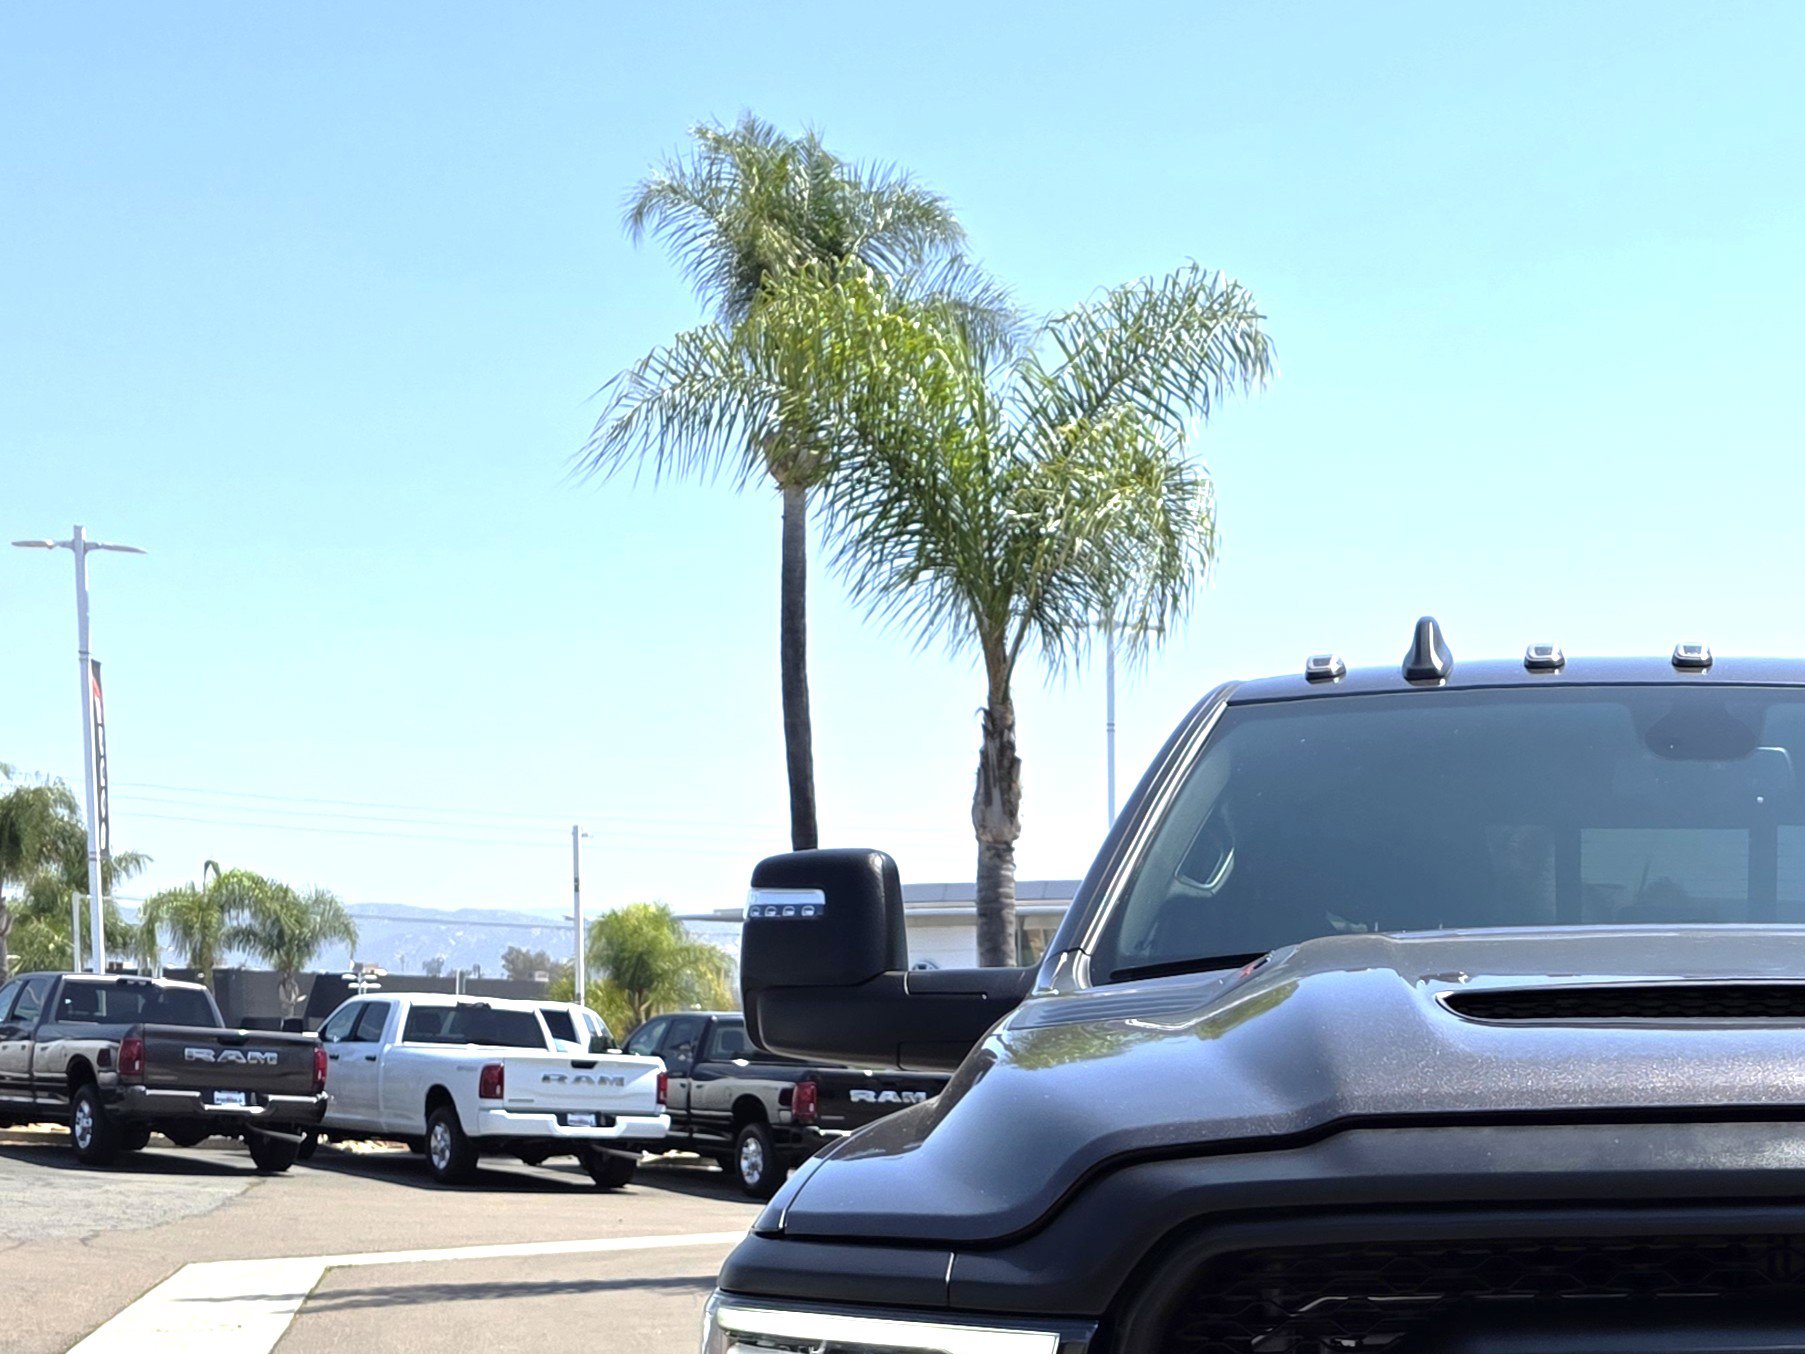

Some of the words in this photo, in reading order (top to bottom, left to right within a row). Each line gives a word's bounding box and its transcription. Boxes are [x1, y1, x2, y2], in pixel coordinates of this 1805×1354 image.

[184, 1047, 278, 1065] RAM
[541, 1073, 626, 1088] RAM
[849, 1089, 927, 1103] RAM
